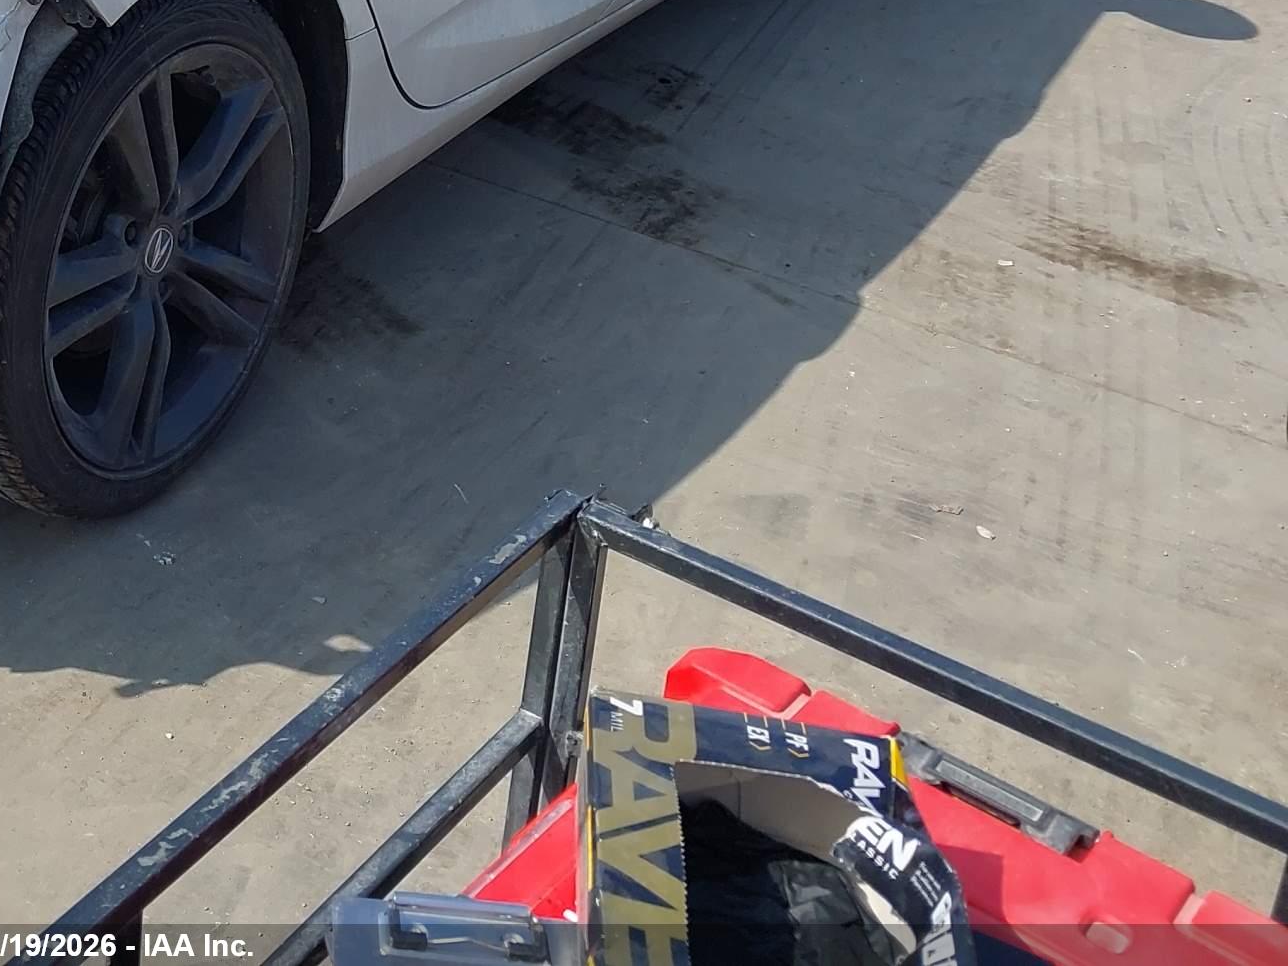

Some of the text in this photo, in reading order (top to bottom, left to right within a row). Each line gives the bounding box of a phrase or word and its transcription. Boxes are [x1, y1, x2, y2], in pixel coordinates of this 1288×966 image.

[610, 696, 644, 733] 7 MIL
[746, 724, 771, 745] EX
[784, 731, 810, 752] PF
